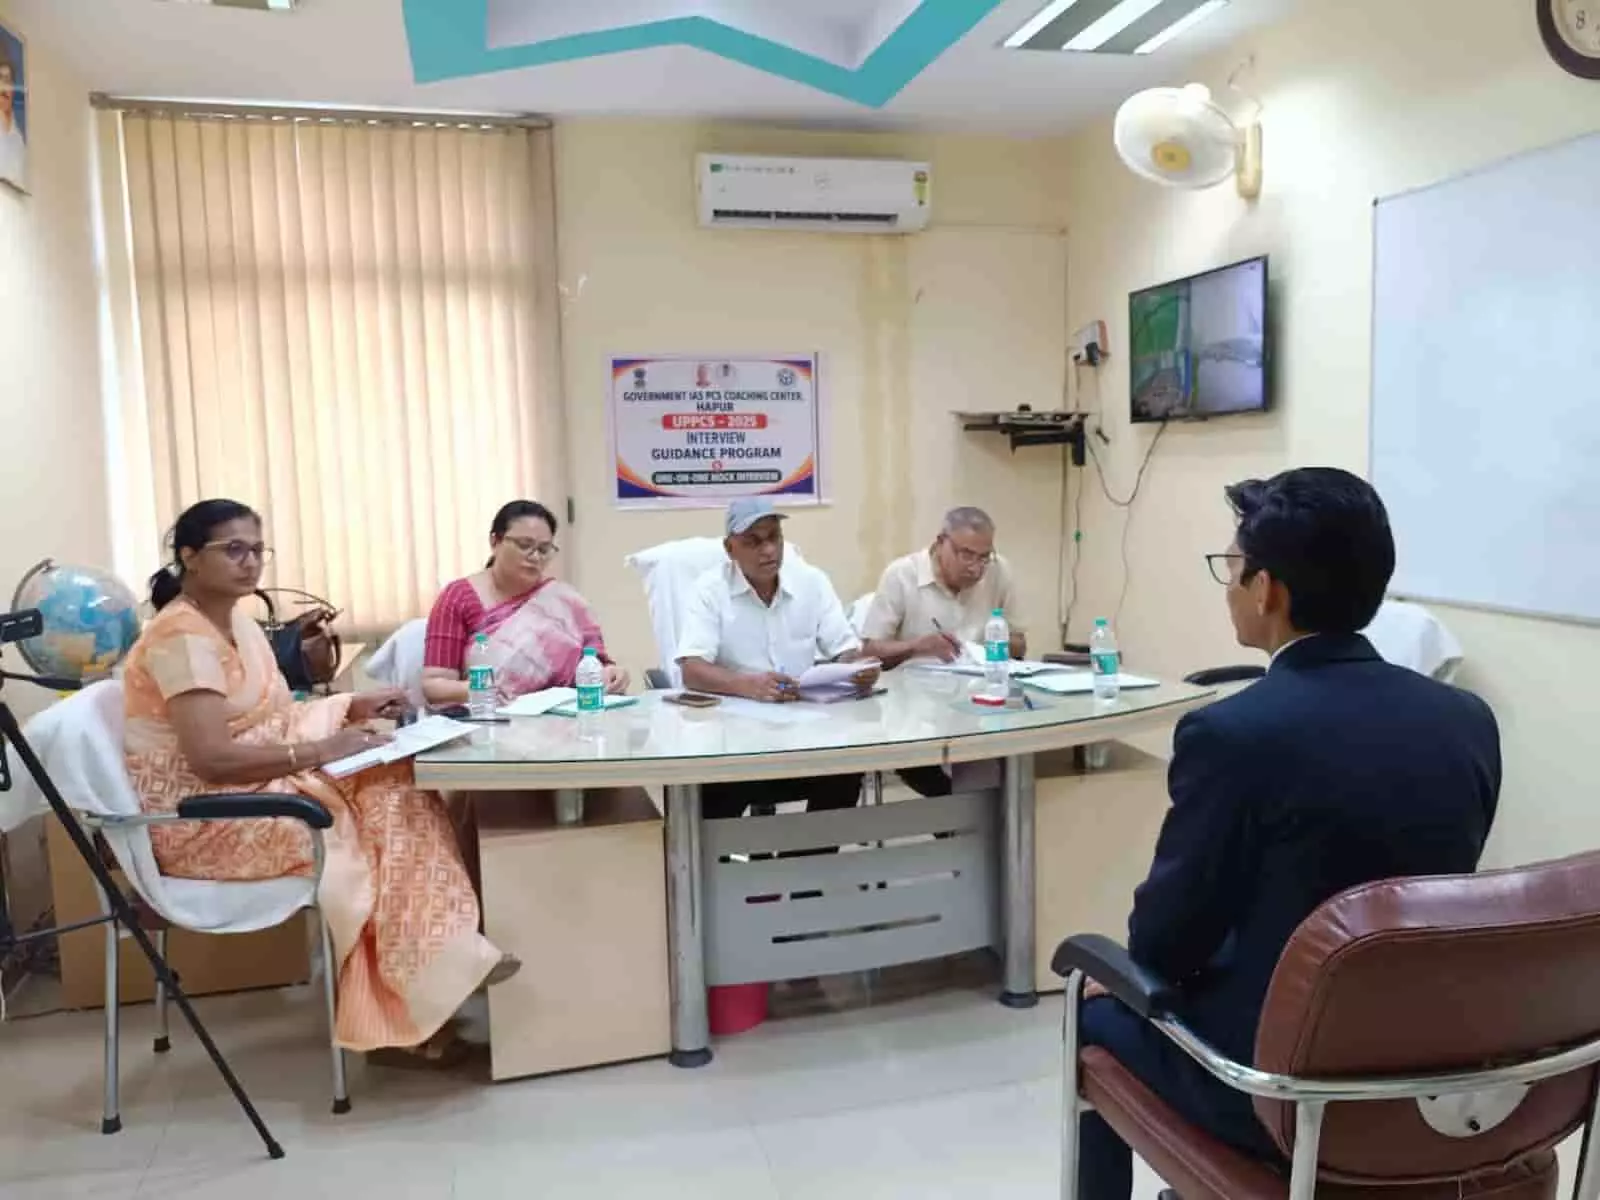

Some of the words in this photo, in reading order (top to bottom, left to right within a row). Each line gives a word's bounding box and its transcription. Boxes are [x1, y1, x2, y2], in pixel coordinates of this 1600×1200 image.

[1575, 9, 1585, 30] 8
[623, 391, 686, 401] GOVERNMENT
[689, 391, 704, 400] IAS
[706, 391, 721, 400] PCS
[723, 391, 768, 400] COACHING
[696, 401, 734, 412] HAPUR
[672, 415, 715, 428] UPPCS
[686, 432, 746, 444] INTERVIEW
[651, 447, 715, 460] GUIDANCE
[720, 447, 782, 459] PROGRAM
